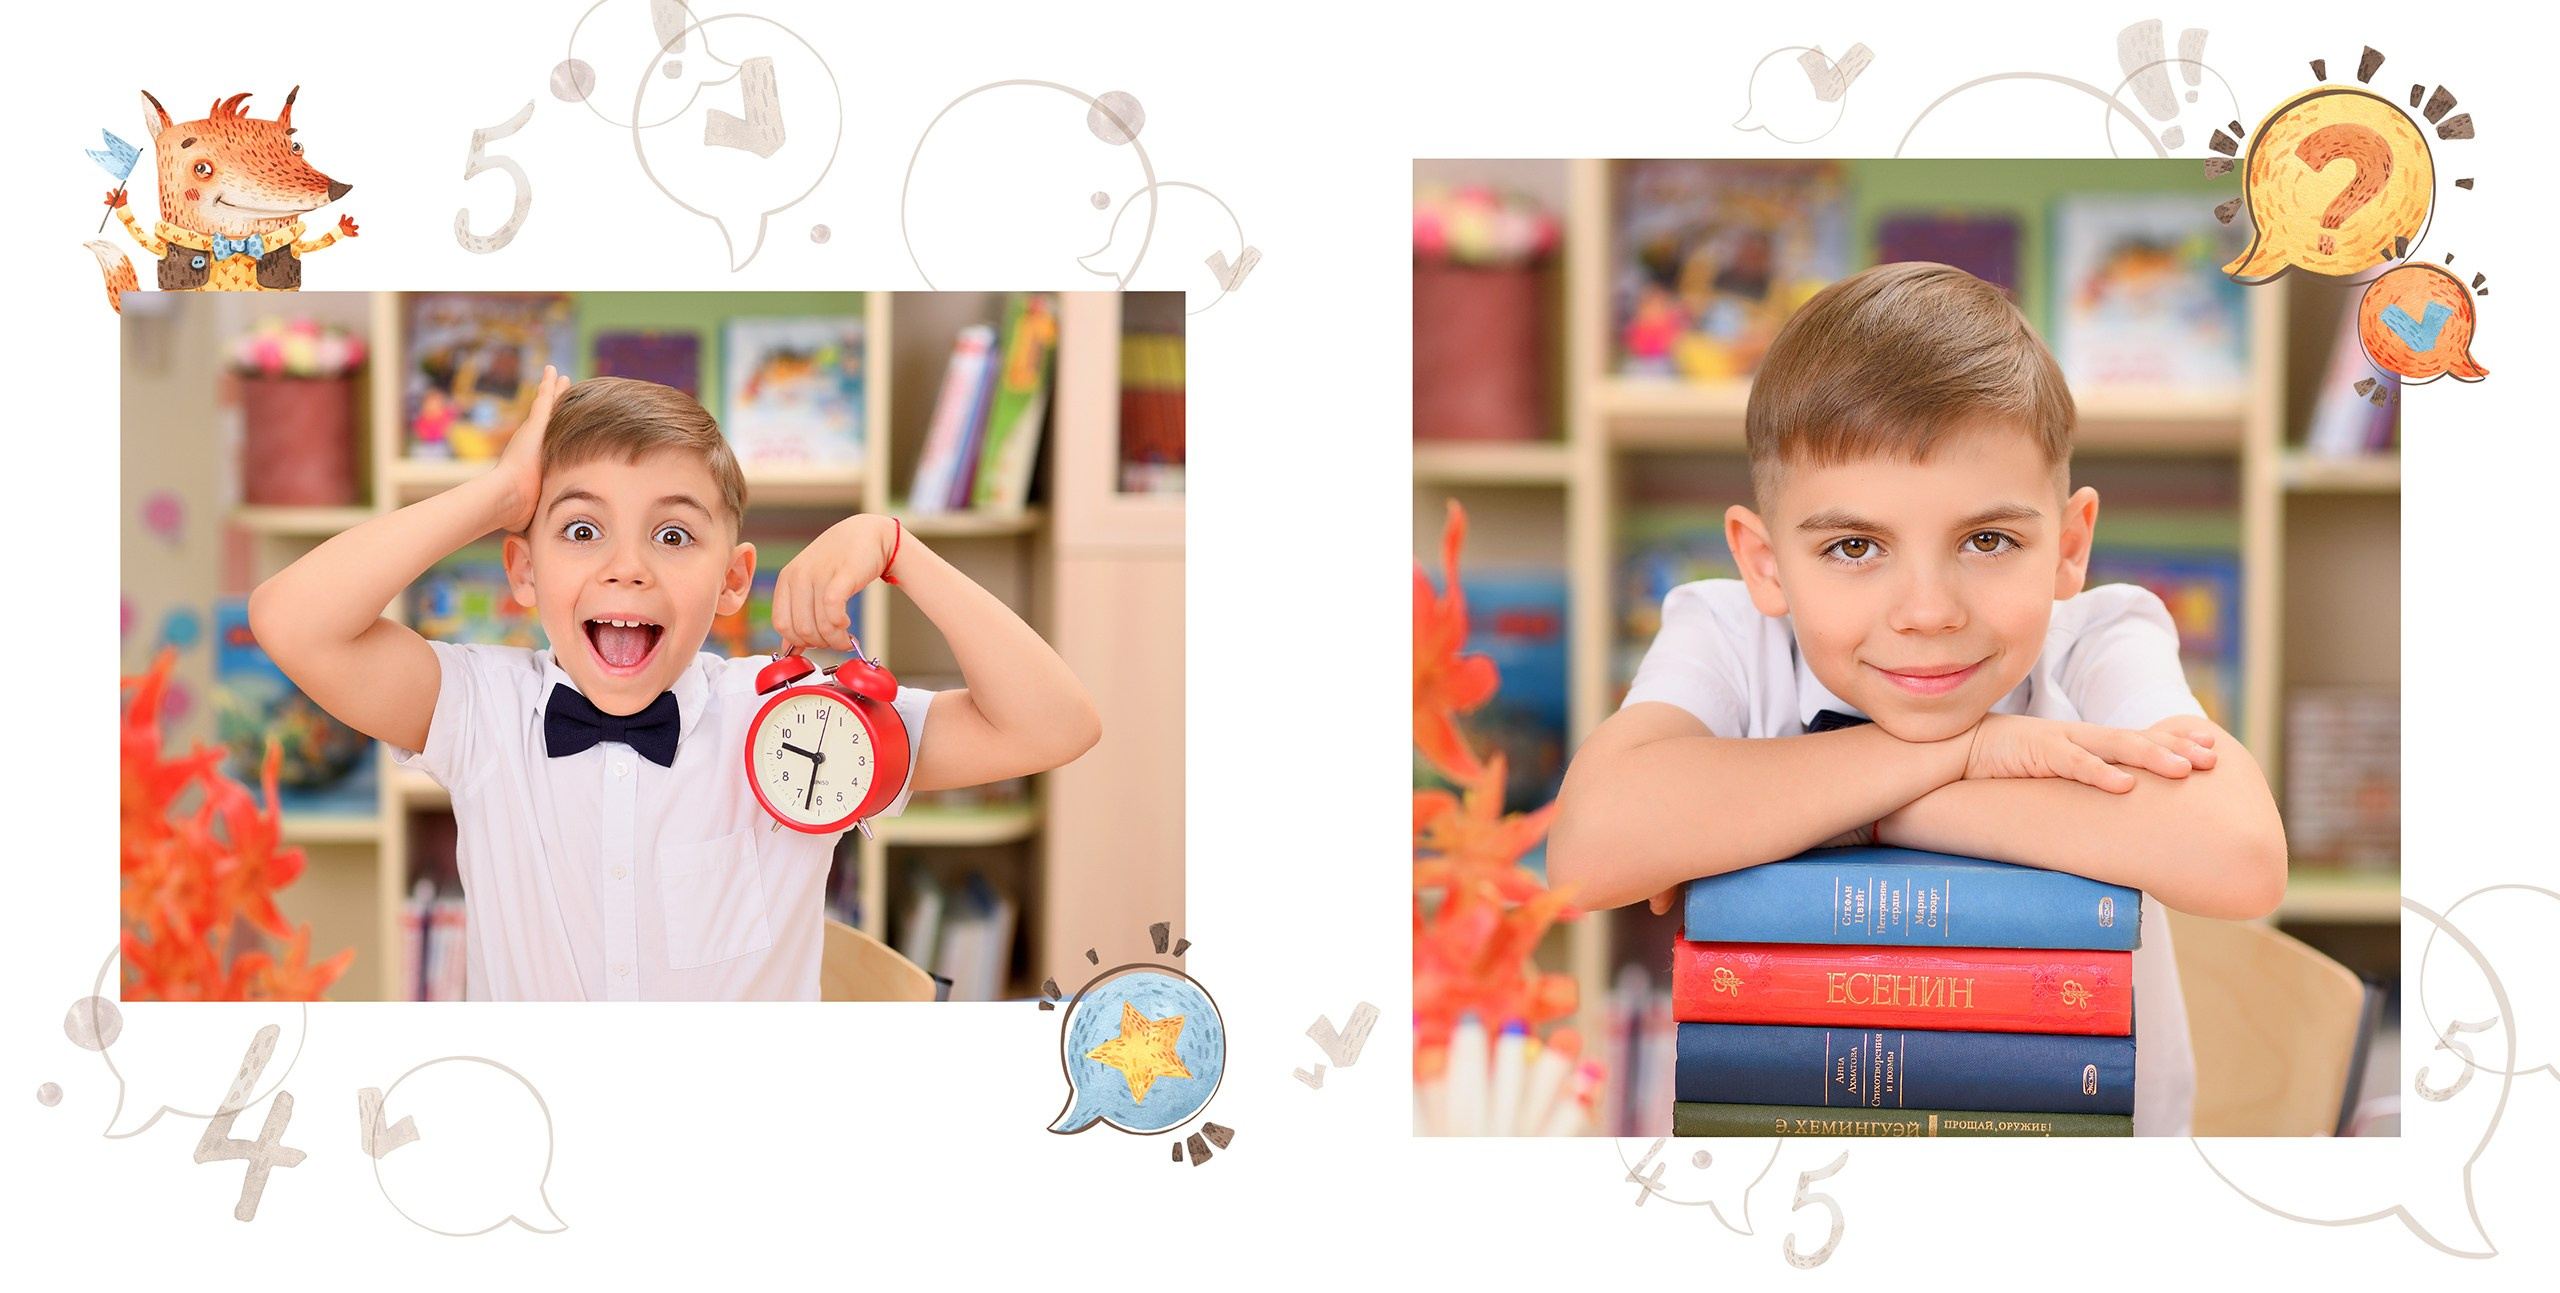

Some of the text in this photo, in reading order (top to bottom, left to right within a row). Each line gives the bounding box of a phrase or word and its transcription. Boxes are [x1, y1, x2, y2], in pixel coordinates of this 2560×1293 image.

[797, 713, 805, 724] 11
[816, 709, 826, 720] 12
[782, 728, 792, 739] 10
[852, 733, 859, 744] 2
[776, 749, 783, 760] 9
[858, 755, 866, 766] 3
[782, 771, 789, 781] 8
[851, 777, 858, 787] 4
[796, 788, 804, 798] 7
[836, 791, 844, 802] 5
[816, 795, 823, 806] 6
[1877, 879, 1889, 935] Нетерпение
[1892, 889, 1902, 926] сердца
[1915, 889, 1928, 926] Мария
[1927, 887, 1941, 928] Стюарт
[1826, 971, 1975, 1009] ЕСЕНИН
[1871, 1033, 1884, 1107] Стихотворения
[1886, 1050, 1895, 1083] поэмы
[1775, 1118, 1921, 1137] Э. ХЕМИНГУЭЙ
